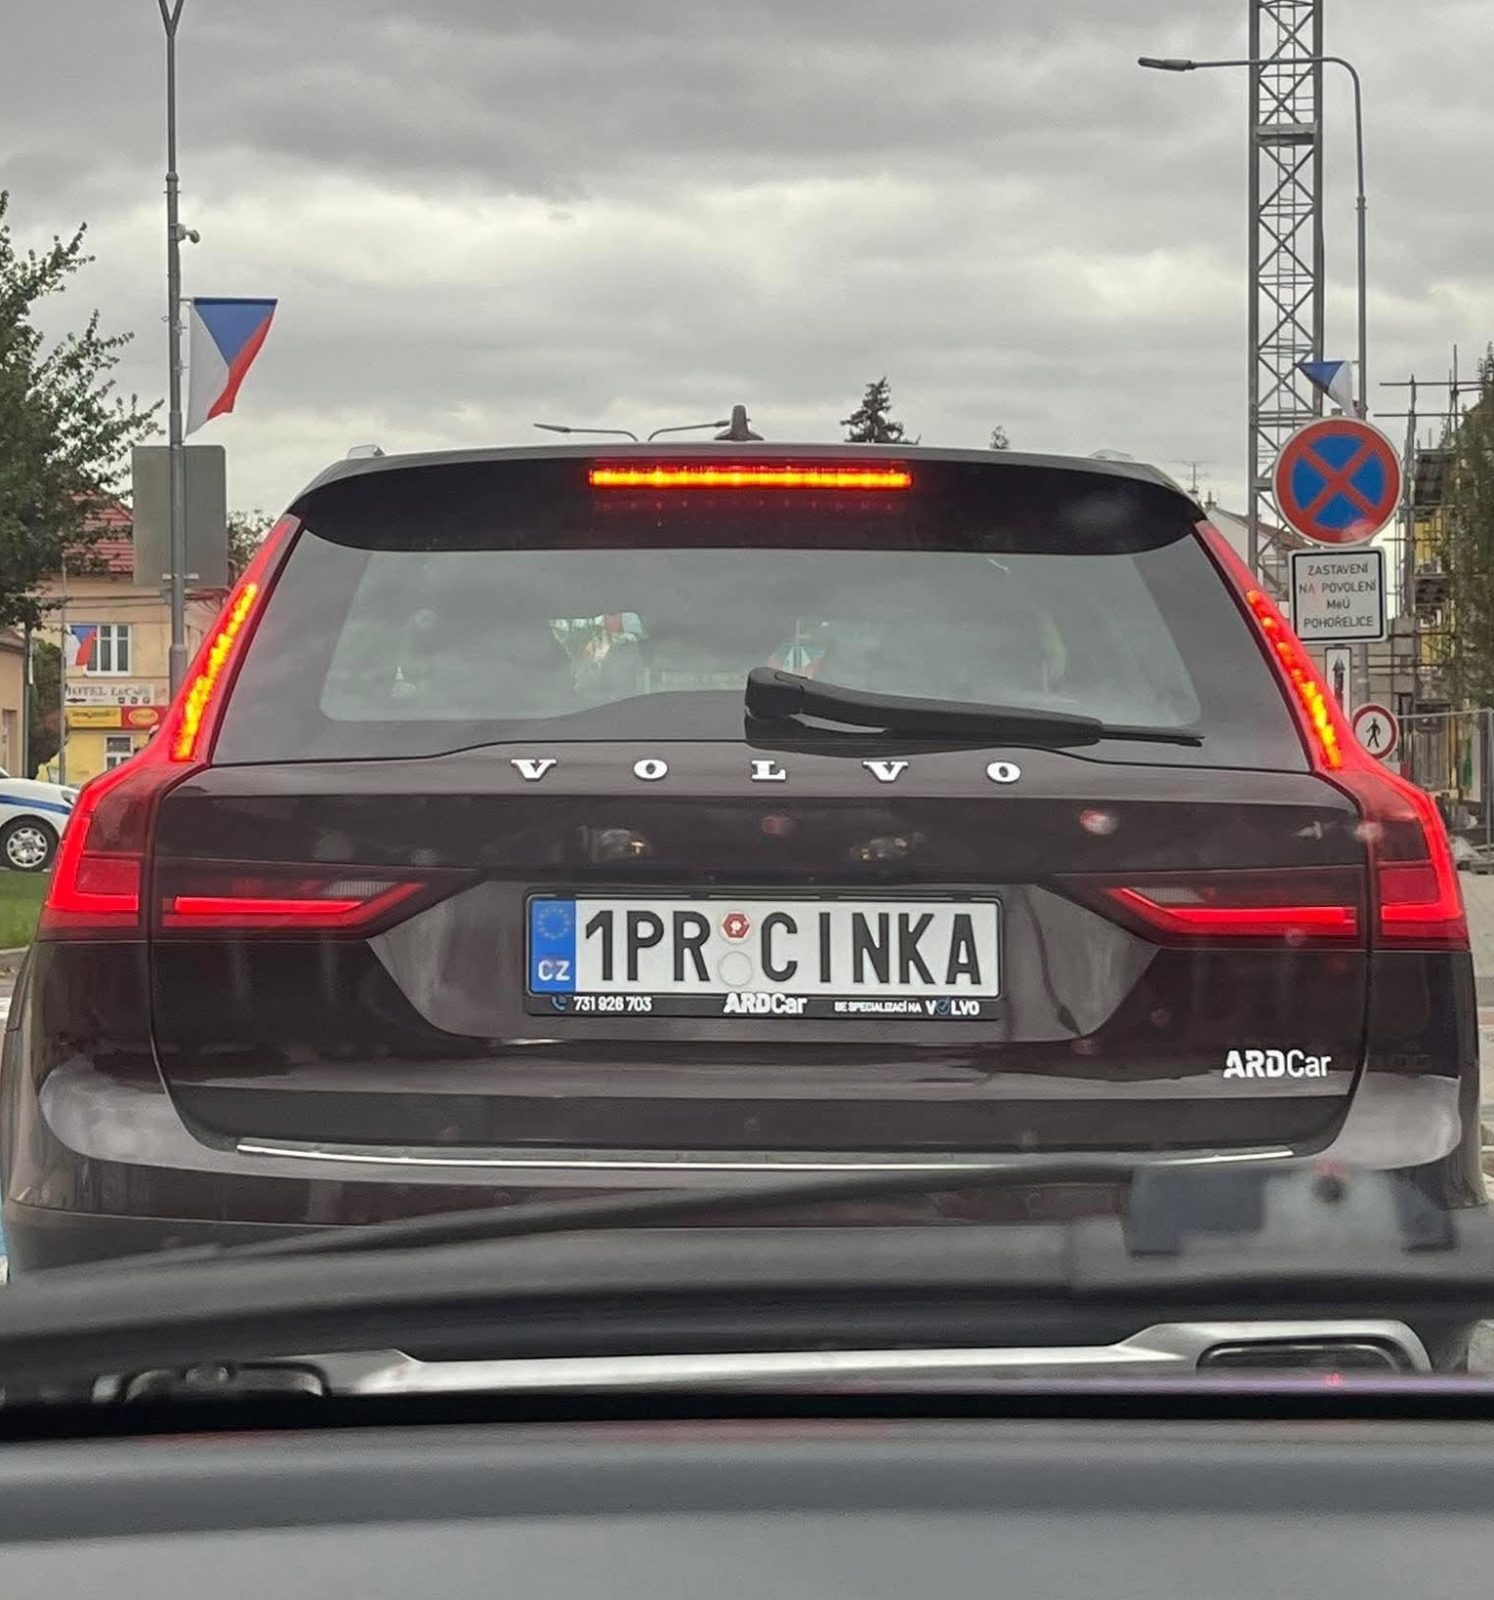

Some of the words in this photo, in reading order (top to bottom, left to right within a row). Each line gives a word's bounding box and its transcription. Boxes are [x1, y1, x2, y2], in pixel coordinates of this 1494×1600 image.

[1307, 562, 1369, 576] ZASTAVENÍ
[1299, 583, 1316, 595] NA
[1321, 580, 1377, 594] POVOLENÍ
[1303, 614, 1374, 629] POHOŘELICE
[511, 758, 1021, 783] VOLVO
[537, 959, 570, 981] CZ
[573, 996, 596, 1012] 731
[626, 996, 652, 1012] 703
[723, 992, 808, 1014] ARDCar
[848, 1000, 907, 1012] SPECIALIZACÍ
[908, 1002, 922, 1012] NA
[1223, 1049, 1332, 1078] ARDCar
